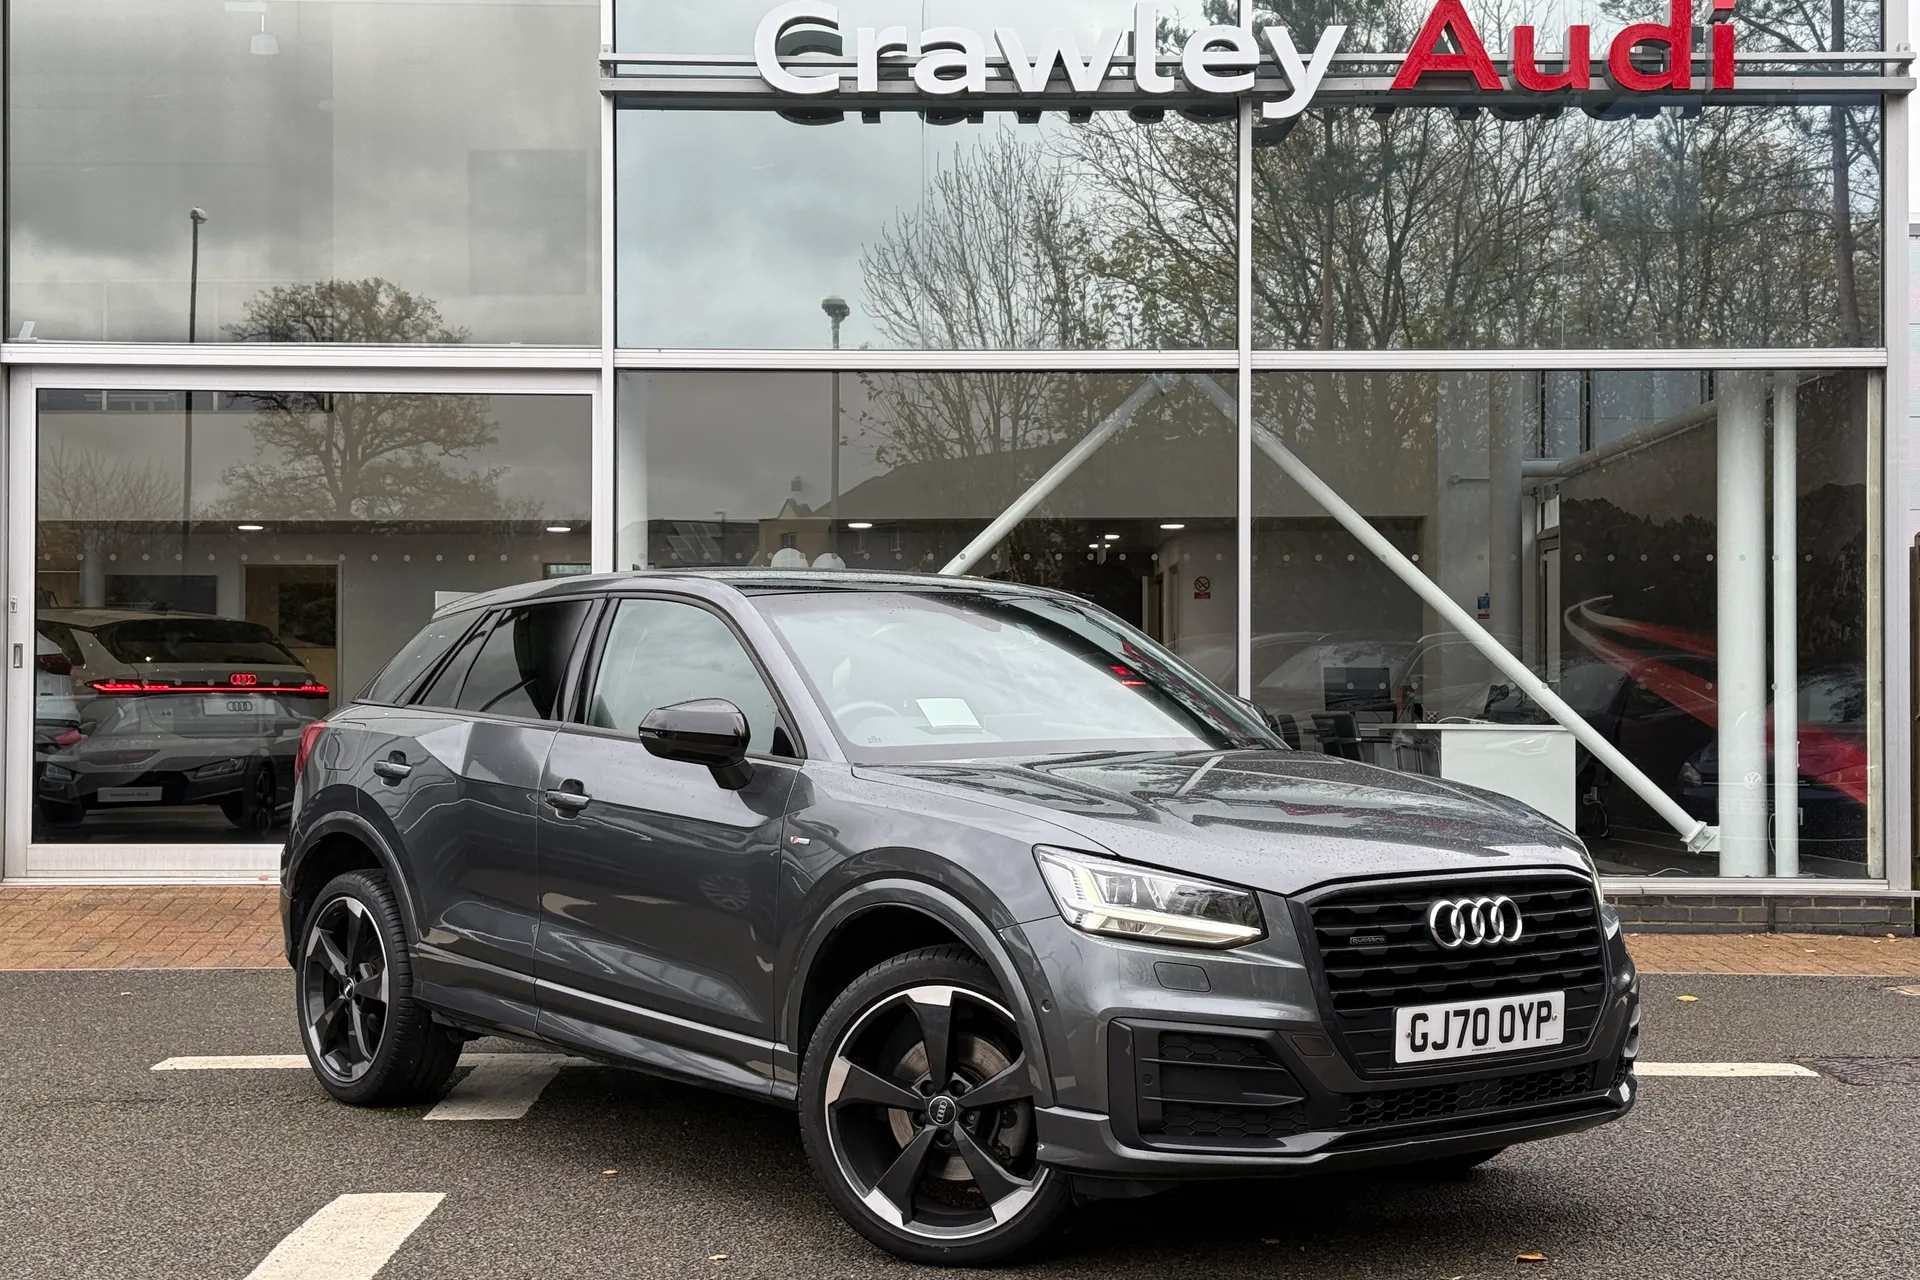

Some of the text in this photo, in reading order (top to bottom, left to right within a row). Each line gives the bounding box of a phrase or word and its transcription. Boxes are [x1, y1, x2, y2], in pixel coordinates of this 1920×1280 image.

[754, 0, 1734, 119] Crawley Audi
[1410, 1000, 1552, 1052] GJ70 OYP
